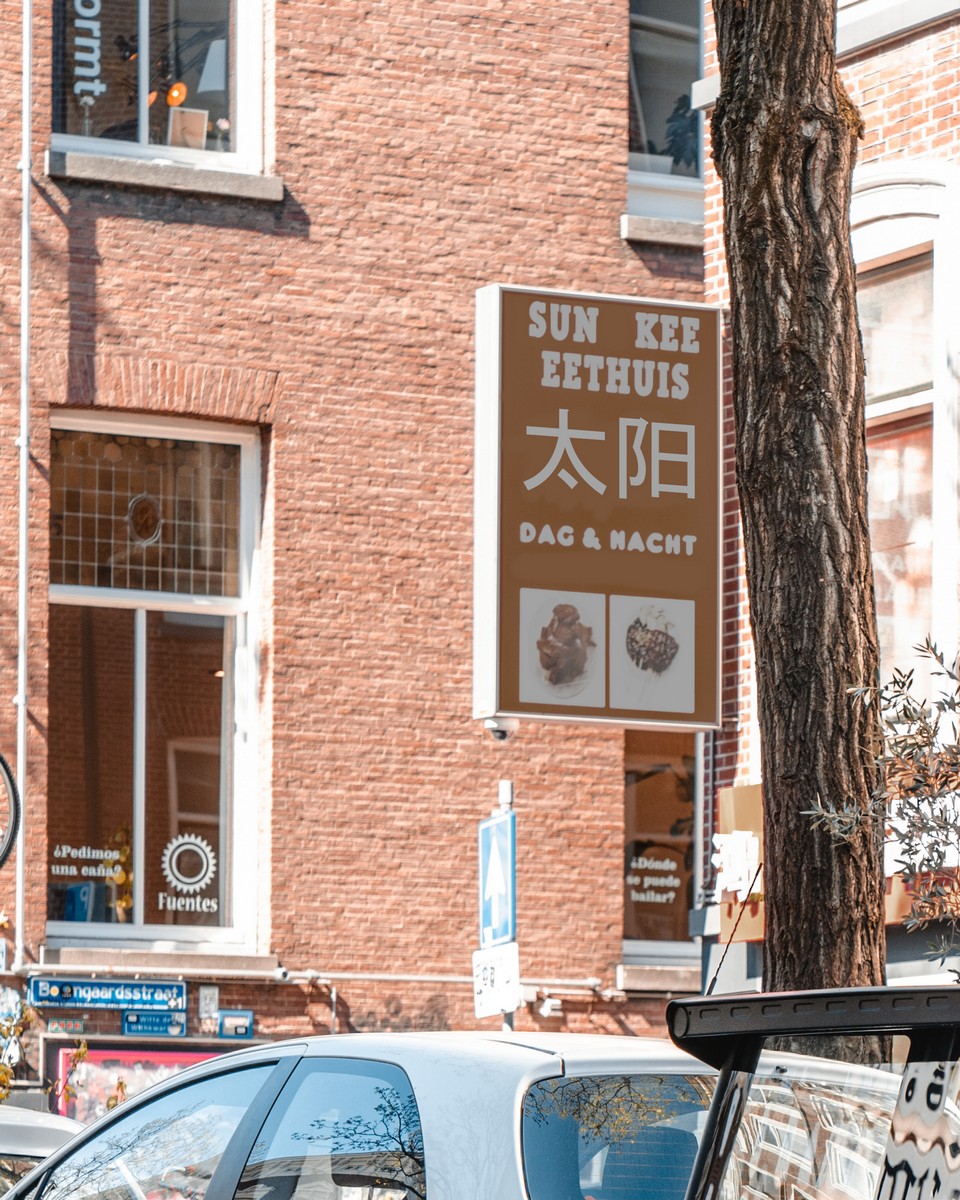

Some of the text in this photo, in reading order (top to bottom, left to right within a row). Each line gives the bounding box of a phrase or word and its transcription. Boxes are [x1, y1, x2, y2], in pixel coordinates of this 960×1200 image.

[528, 301, 700, 353] SUN KEE
[541, 350, 690, 400] EETHUIS
[523, 408, 696, 499] 太阳
[519, 521, 698, 556] DAG & NACHT
[53, 844, 120, 860] ¿Pedimos
[51, 863, 122, 877] una caña?
[630, 856, 678, 871] ¿Dónde
[625, 874, 681, 889] se puede
[158, 891, 218, 913] Fuentes
[630, 889, 676, 904] bailar?
